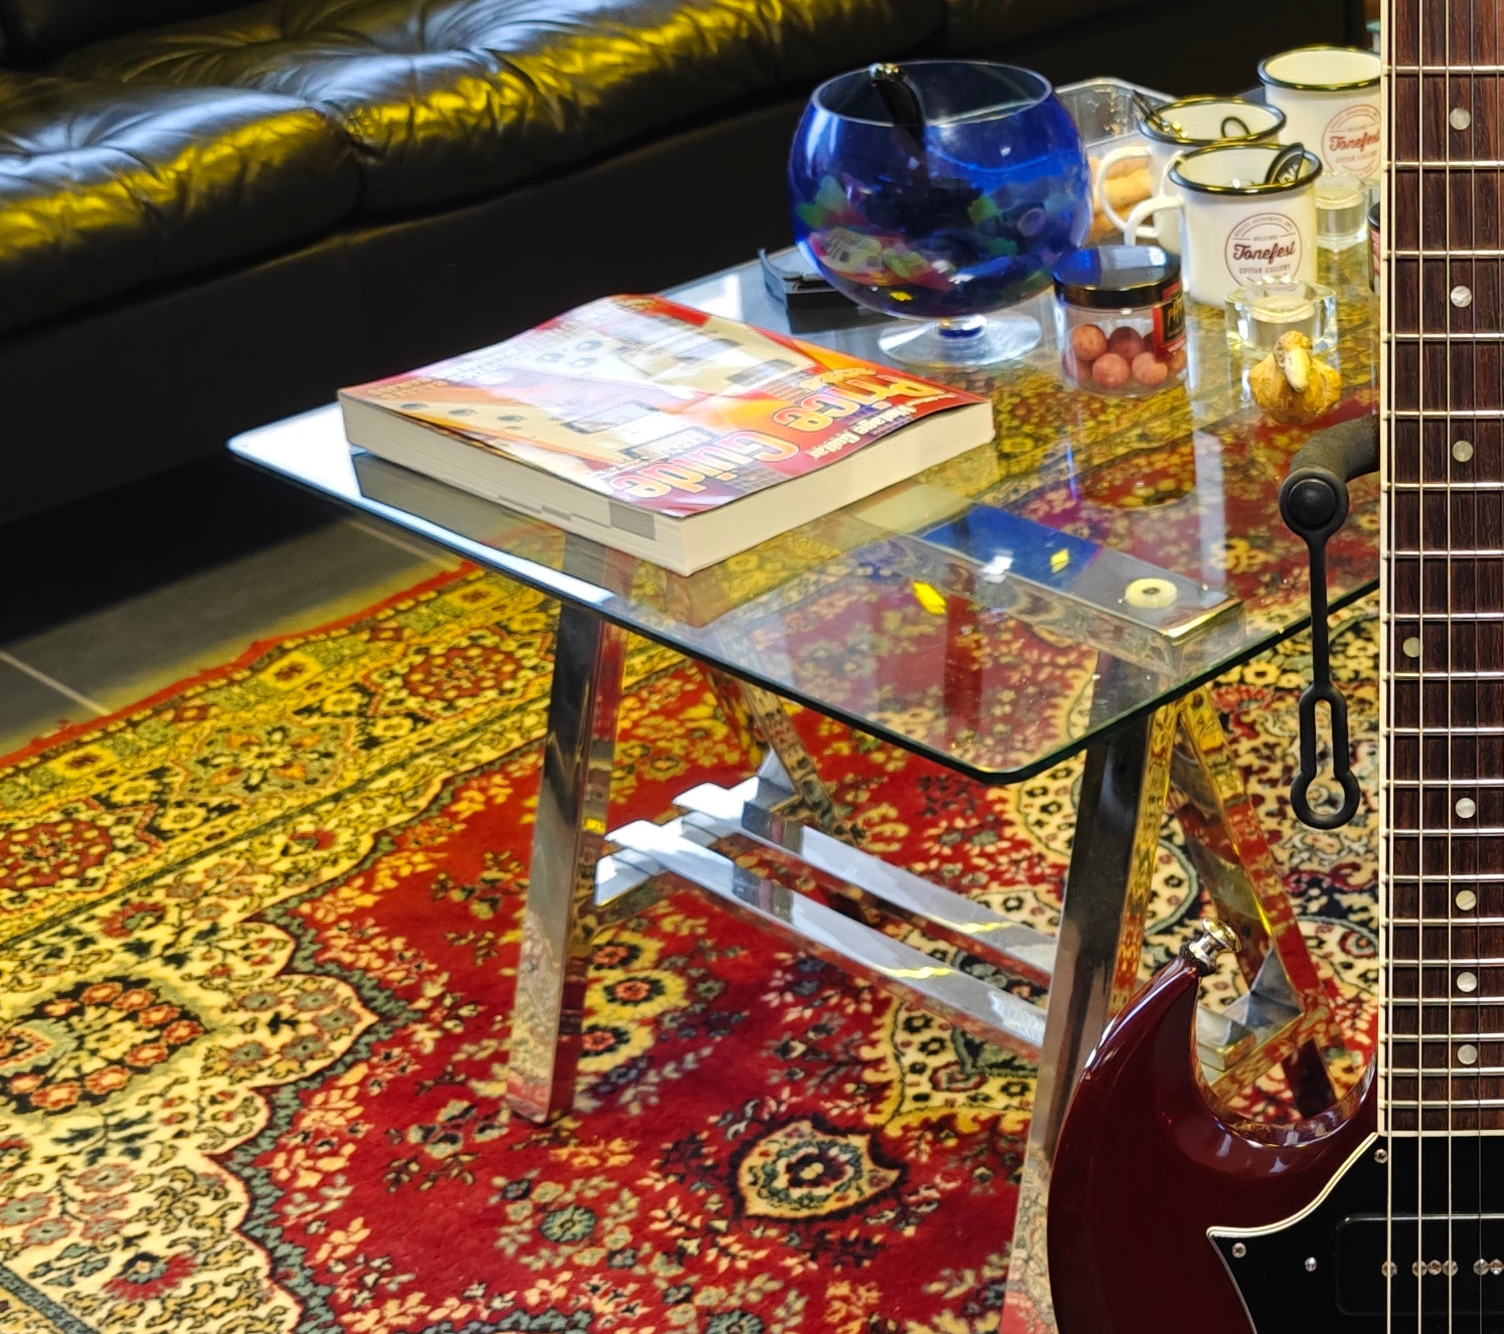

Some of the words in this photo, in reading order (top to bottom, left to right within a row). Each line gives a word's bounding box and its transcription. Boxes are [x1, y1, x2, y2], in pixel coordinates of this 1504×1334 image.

[1232, 240, 1296, 266] Tonefest
[773, 373, 947, 434] Price
[608, 430, 802, 500] Guide
